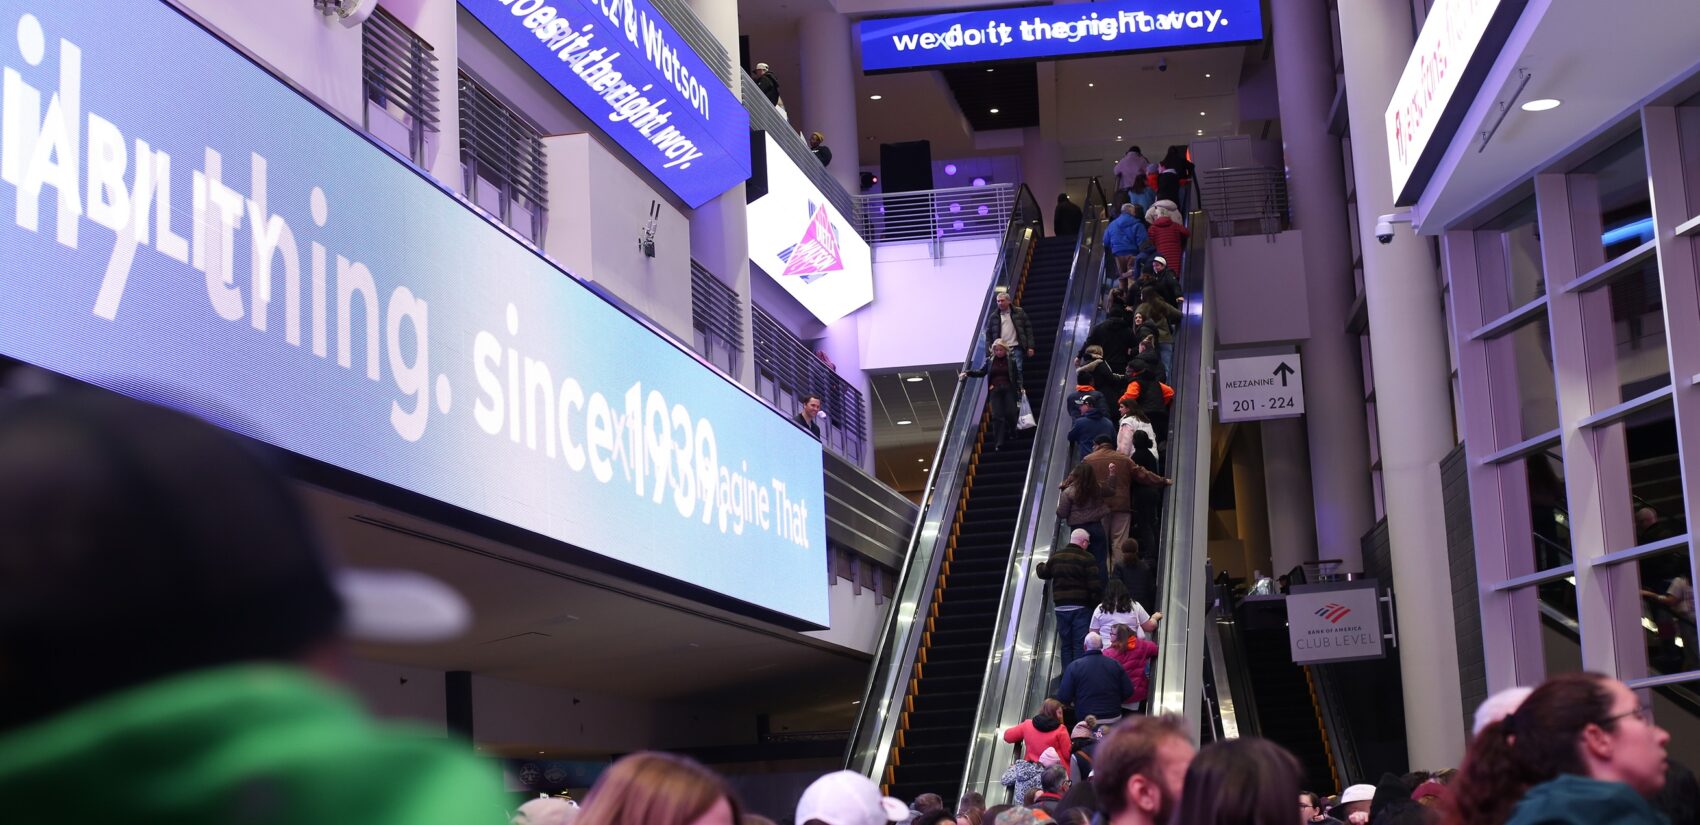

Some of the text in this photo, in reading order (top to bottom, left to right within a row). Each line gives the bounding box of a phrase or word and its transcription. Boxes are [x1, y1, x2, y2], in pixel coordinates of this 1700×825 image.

[893, 32, 935, 51] we
[946, 24, 982, 48] do
[1020, 17, 1068, 42] the
[1078, 10, 1151, 41] right
[1160, 9, 1228, 32] way.
[641, 10, 709, 120] Watson
[573, 47, 622, 92] the
[651, 125, 704, 169] way.
[203, 146, 452, 442] thing.
[473, 302, 614, 483] since
[625, 381, 729, 534] 1939.
[1225, 378, 1275, 389] MEZZANINE
[1233, 399, 1256, 412] 201
[1269, 396, 1294, 409] 224
[771, 478, 810, 549] That
[1296, 633, 1376, 650] CLUB LEVEL
